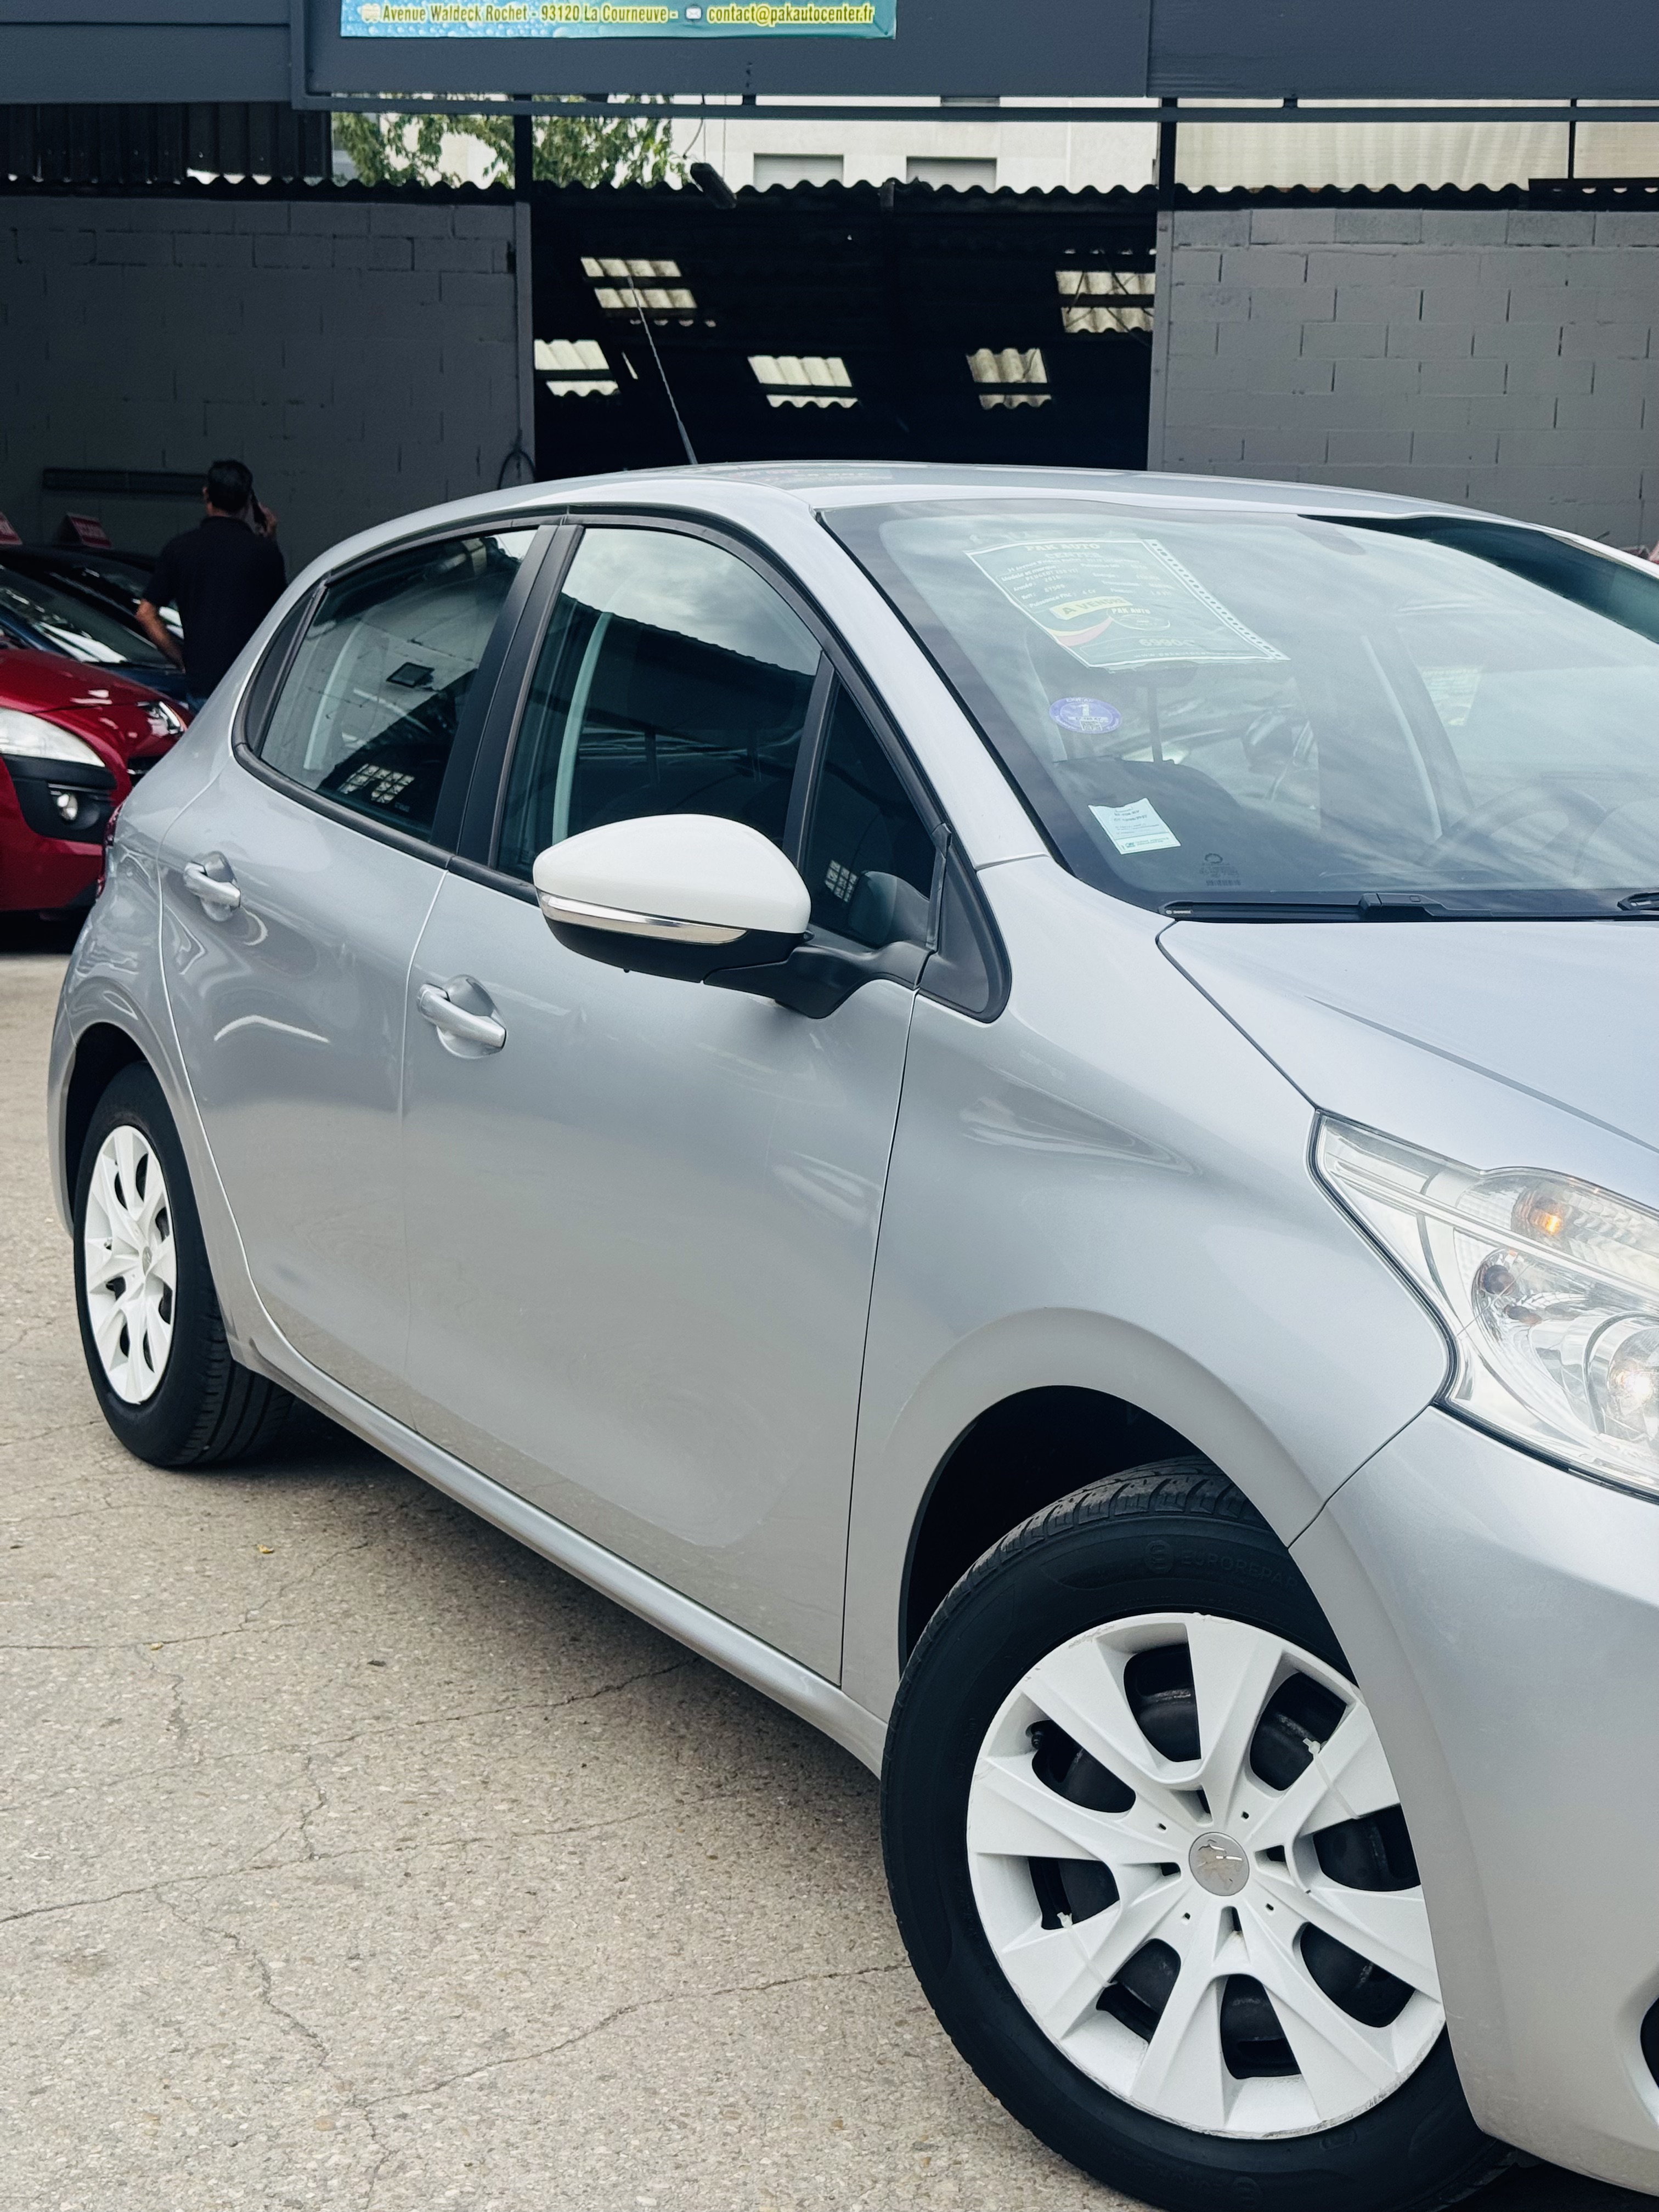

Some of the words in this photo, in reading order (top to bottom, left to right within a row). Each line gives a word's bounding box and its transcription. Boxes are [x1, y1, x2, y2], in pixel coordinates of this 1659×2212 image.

[384, 5, 426, 21] Avenue
[431, 5, 482, 21] Waldeck
[486, 5, 528, 21] Rochet
[541, 4, 579, 21] 93120
[585, 5, 598, 21] La
[603, 4, 667, 21] Courneuve
[708, 5, 874, 25] contact@pakautocenter.fr
[1062, 607, 1077, 615] A
[1075, 598, 1127, 610] VENDRE
